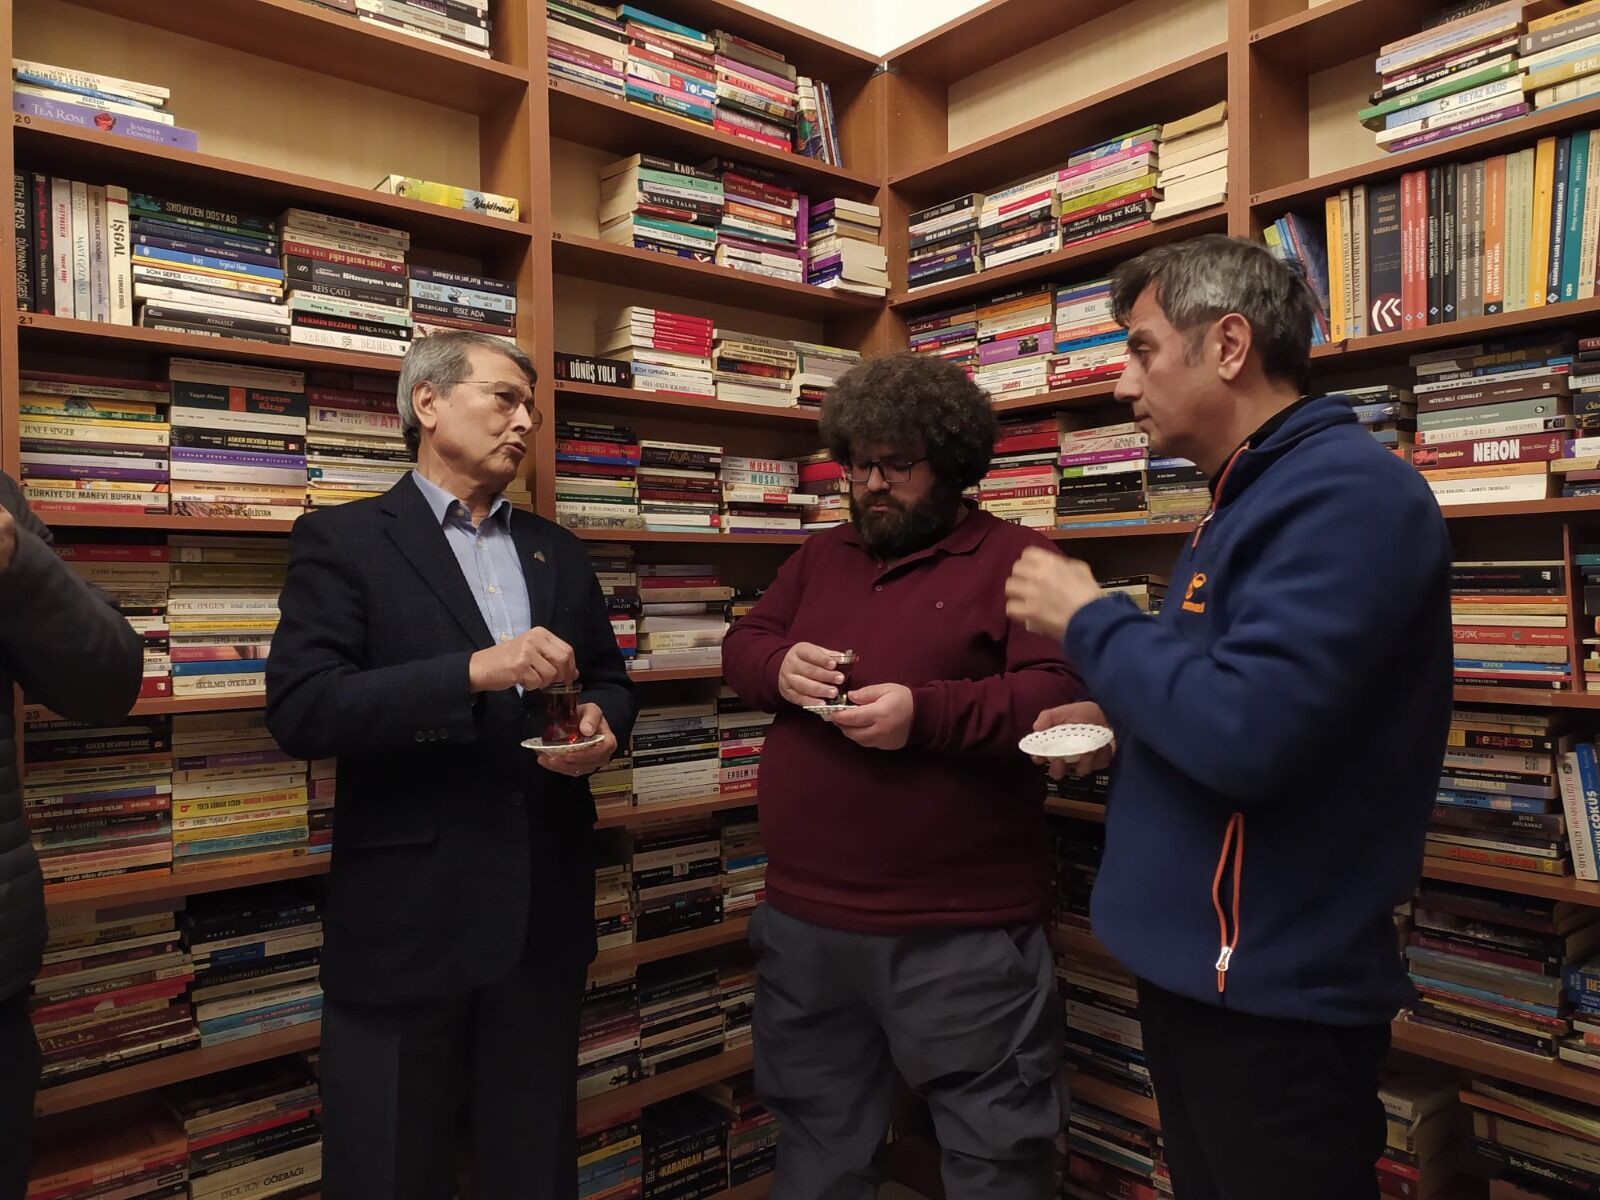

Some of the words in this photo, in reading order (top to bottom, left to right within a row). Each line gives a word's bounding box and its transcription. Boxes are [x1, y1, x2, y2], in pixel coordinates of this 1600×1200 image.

[31, 103, 54, 118] TEA
[15, 114, 31, 126] 20
[673, 162, 696, 177] KAOS
[166, 201, 205, 218] SNOWDEN
[205, 208, 238, 225] DOSYASI
[109, 219, 126, 259] İŞGAL
[342, 272, 385, 286] Bitmeyen
[19, 316, 33, 326] 21
[470, 309, 486, 319] ADA
[569, 360, 597, 384] DÖNÜŞ
[598, 364, 617, 385] YOLU
[1473, 439, 1520, 463] NERON
[28, 487, 75, 499] TÜRKİYE'DE
[78, 489, 109, 500] MANEVİ
[110, 492, 142, 501] BUHRAN
[25, 711, 40, 720] 23
[727, 769, 749, 780] ERDEM
